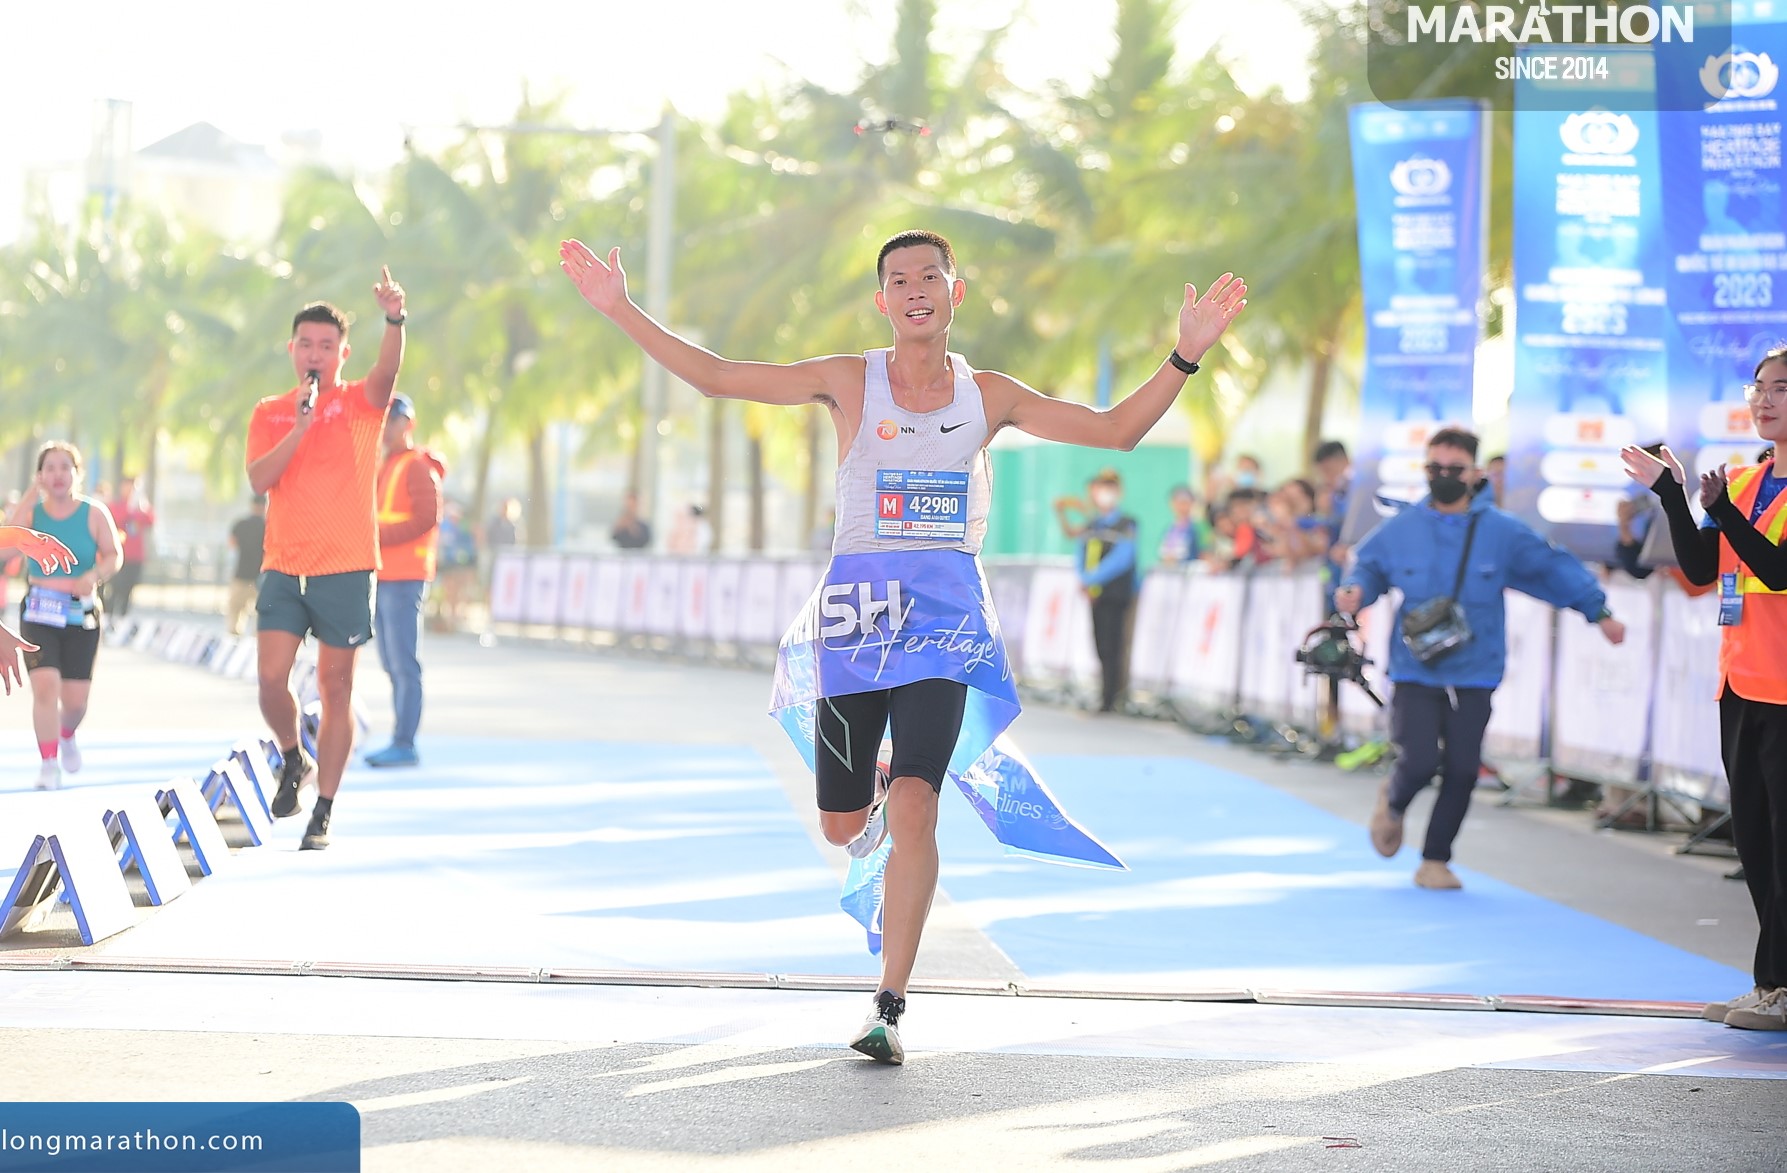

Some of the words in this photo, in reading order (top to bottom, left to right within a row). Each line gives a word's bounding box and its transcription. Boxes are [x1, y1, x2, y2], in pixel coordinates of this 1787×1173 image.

[1713, 272, 1773, 307] 2023
[883, 498, 897, 515] M
[909, 496, 959, 514] 42980
[822, 597, 997, 682] Heritage
